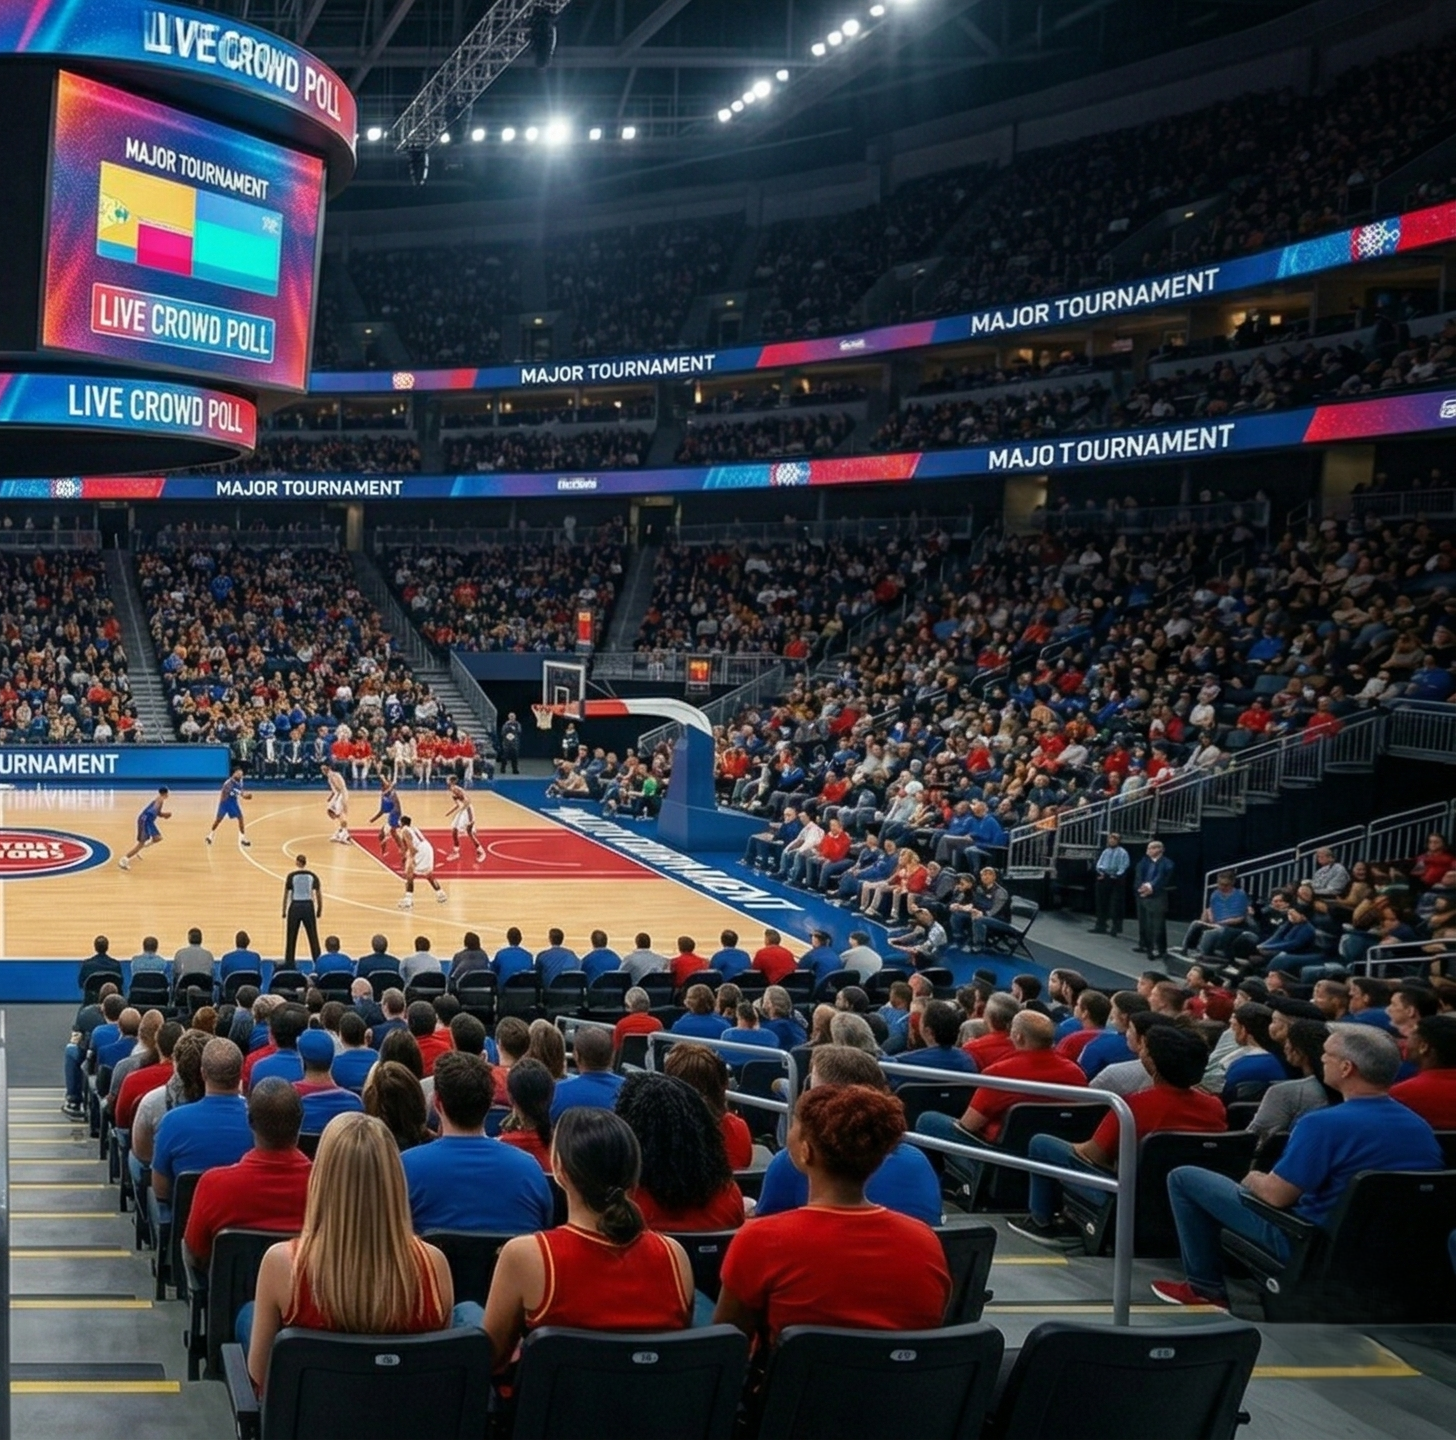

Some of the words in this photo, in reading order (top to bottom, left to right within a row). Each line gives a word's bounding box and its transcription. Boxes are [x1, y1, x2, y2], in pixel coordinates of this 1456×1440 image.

[304, 65, 341, 122] POLL
[125, 137, 177, 173] MAJOR
[179, 153, 270, 200] TOURNAMENT
[100, 294, 147, 332] LIVE
[151, 303, 221, 344] CROWD
[225, 319, 270, 355] POLL
[971, 303, 1049, 334] MAJOR
[1054, 268, 1220, 319] TOURNAMENT
[521, 365, 584, 384] MAJOR
[587, 354, 716, 380] TOURNAMENT
[69, 384, 123, 419] LIVE
[130, 389, 204, 427] CROWD
[208, 399, 243, 433] POLL
[988, 444, 1054, 470] MAJO
[1059, 423, 1235, 464] TOURNAMENT
[216, 480, 278, 496] MAJOR
[282, 480, 403, 496] TOURNAMENT
